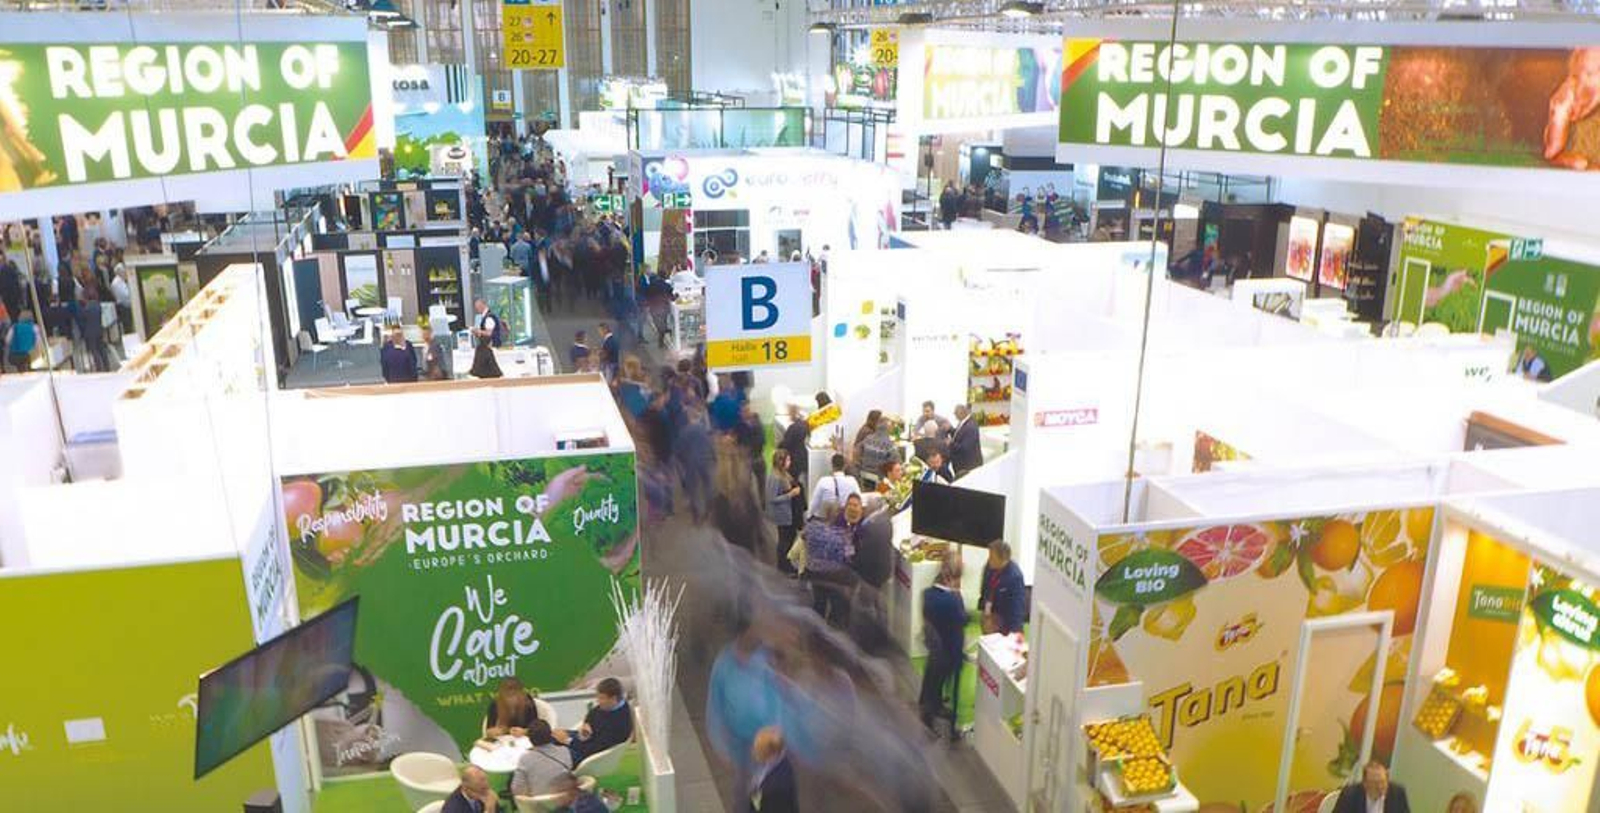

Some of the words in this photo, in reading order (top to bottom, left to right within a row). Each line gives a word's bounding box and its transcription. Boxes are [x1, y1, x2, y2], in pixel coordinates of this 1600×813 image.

[46, 45, 261, 98] REGION
[280, 44, 340, 89] OF
[512, 49, 557, 64] 20-27
[1098, 43, 1286, 86] REGION
[1308, 46, 1383, 89] OF
[58, 102, 348, 182] MURCIA
[1096, 92, 1371, 157] MURCIA
[740, 275, 779, 331] B
[1519, 297, 1563, 321] REGION
[1567, 310, 1585, 326] OF
[1516, 313, 1579, 346] MURCIA
[762, 340, 788, 361] 18
[296, 488, 388, 543] Responsibility
[402, 498, 503, 523] REGION
[515, 494, 549, 513] OF
[573, 493, 619, 537] Quality
[405, 518, 552, 553] MURCIA
[487, 549, 548, 563] ORCHARD
[1039, 534, 1085, 586] MURCIA
[1124, 563, 1179, 580] Loving
[465, 574, 507, 623] We
[1135, 578, 1165, 593] BIO
[430, 606, 540, 681] Care
[463, 655, 519, 686] about
[437, 691, 483, 706] WHAT
[1150, 661, 1280, 749] Tana
